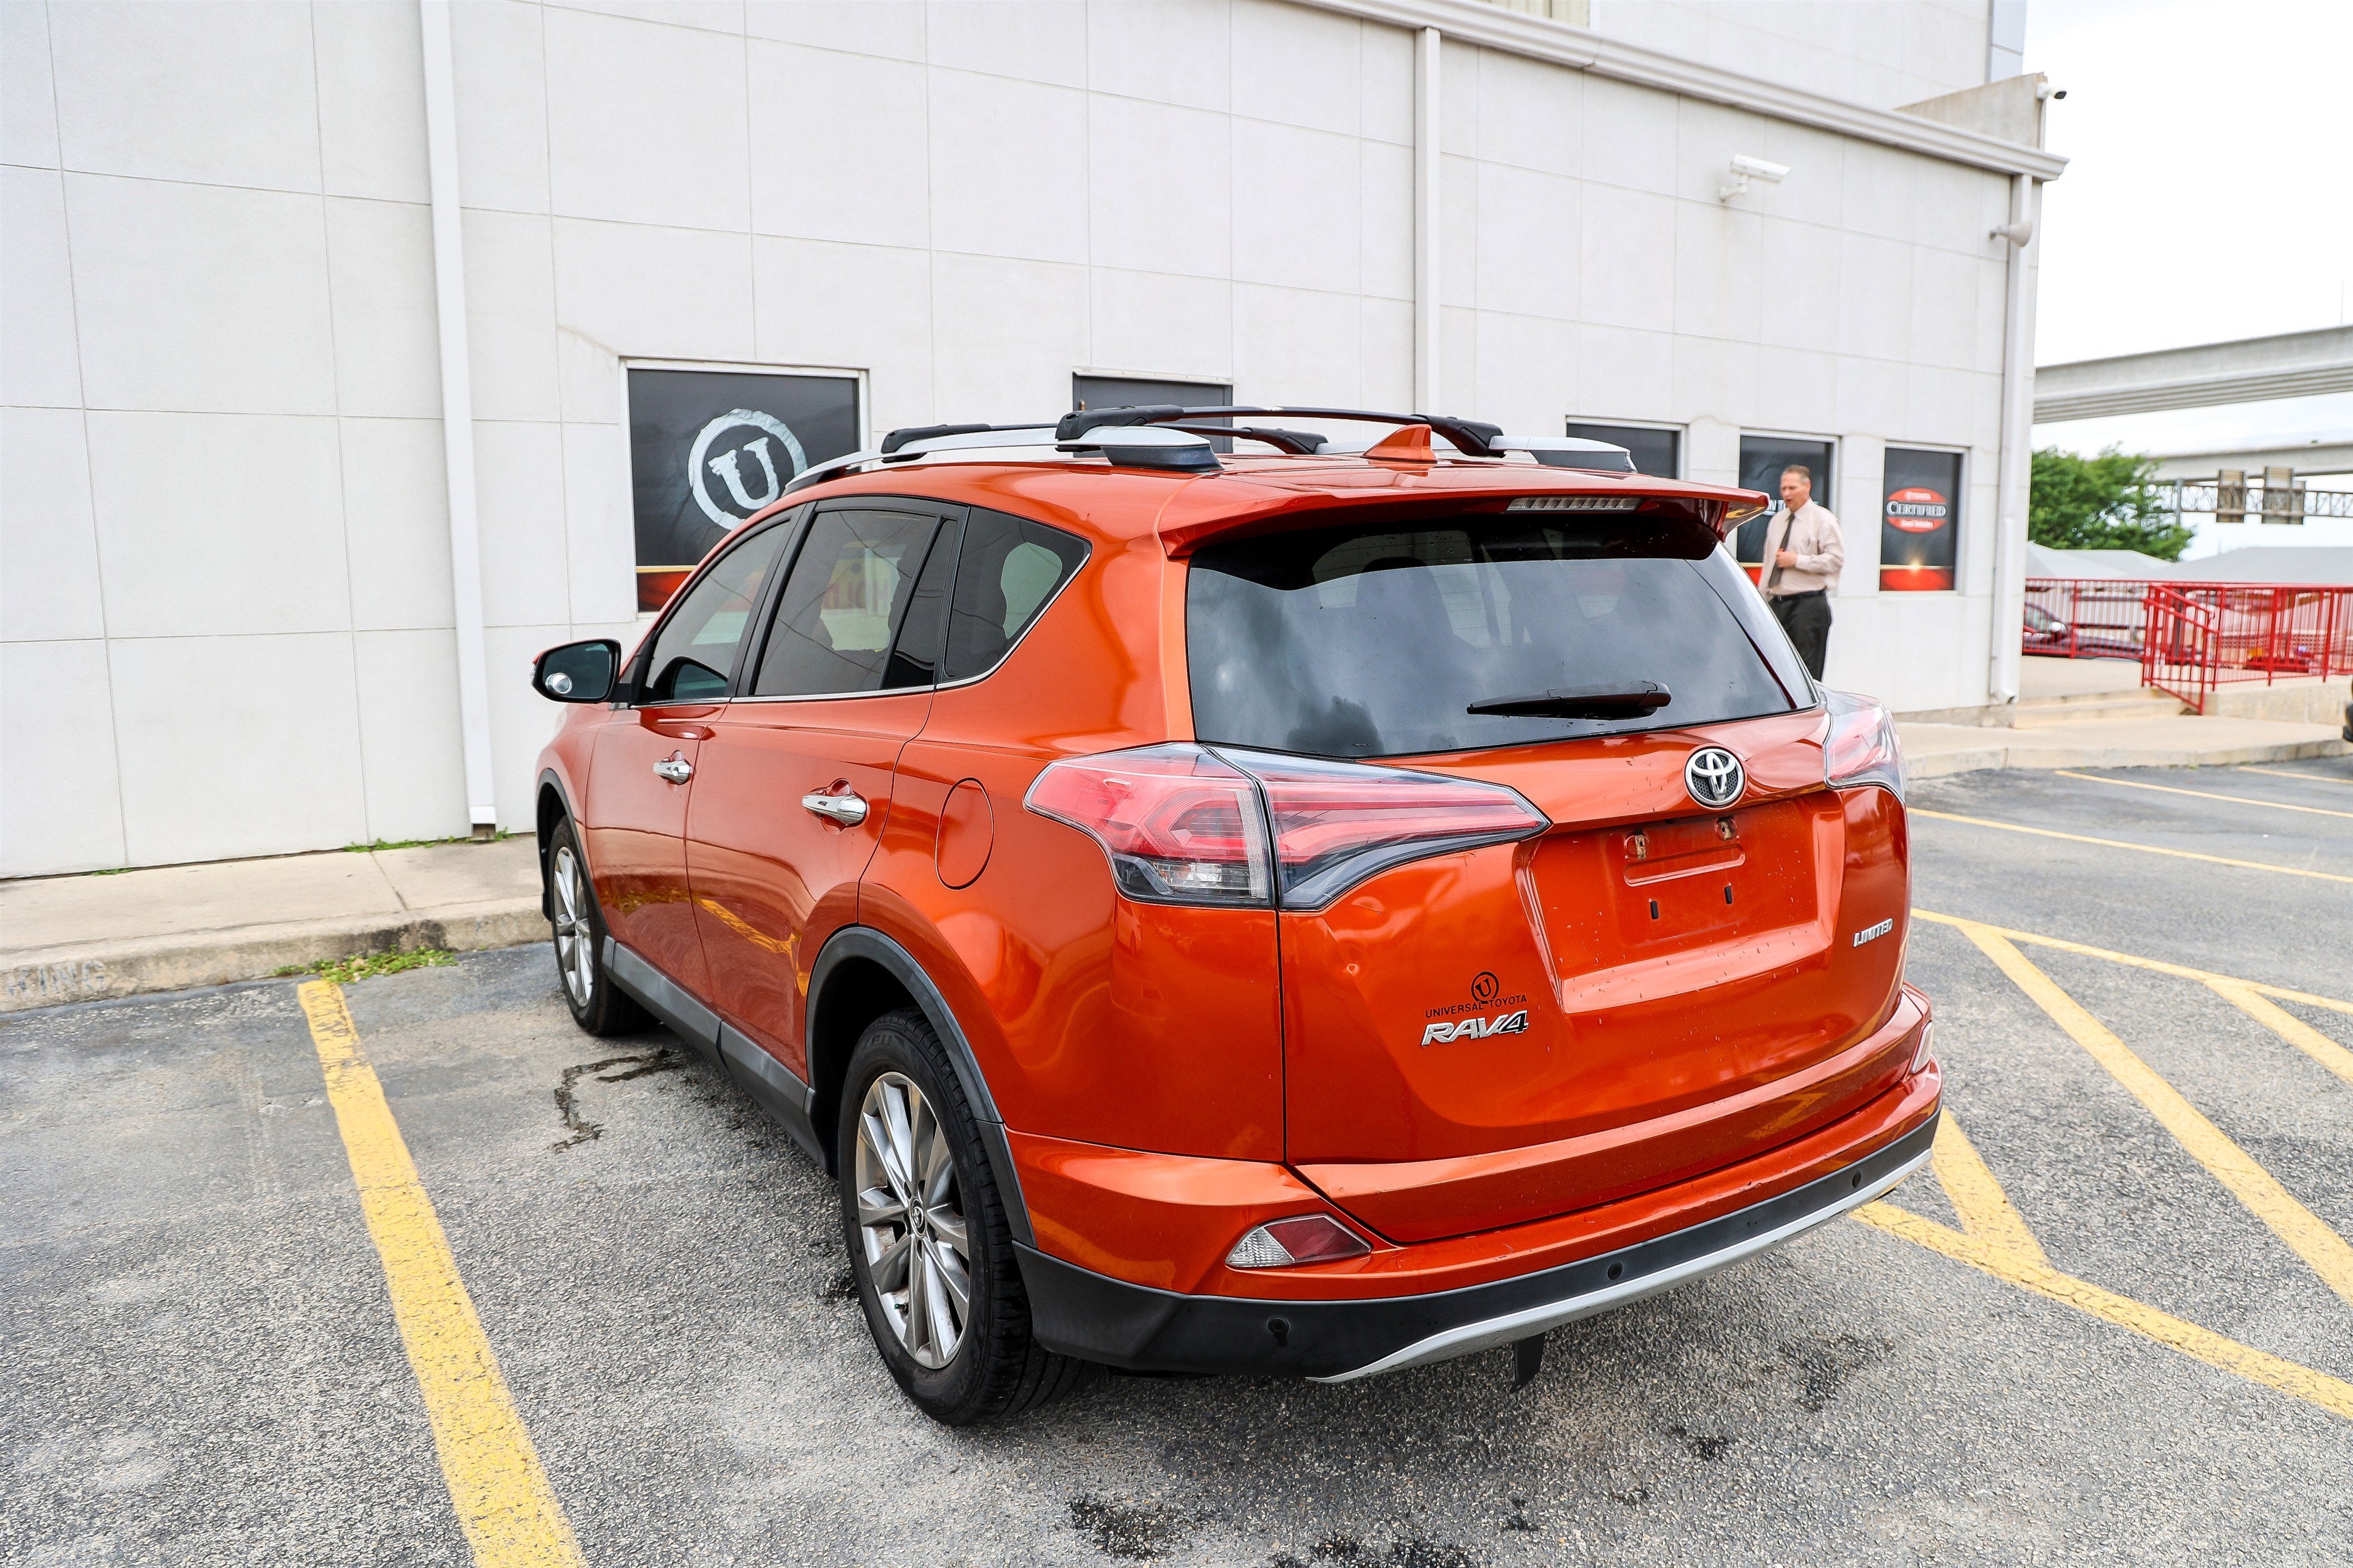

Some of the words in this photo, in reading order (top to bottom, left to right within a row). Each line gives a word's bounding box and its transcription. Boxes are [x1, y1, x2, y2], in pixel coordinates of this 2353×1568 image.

[708, 437, 780, 510] U
[1887, 501, 1946, 517] CERTIFIED
[1425, 1001, 1484, 1018] UNIVERSAL
[1488, 994, 1527, 1008] TOYOTA
[1421, 1010, 1529, 1046] RAV4
